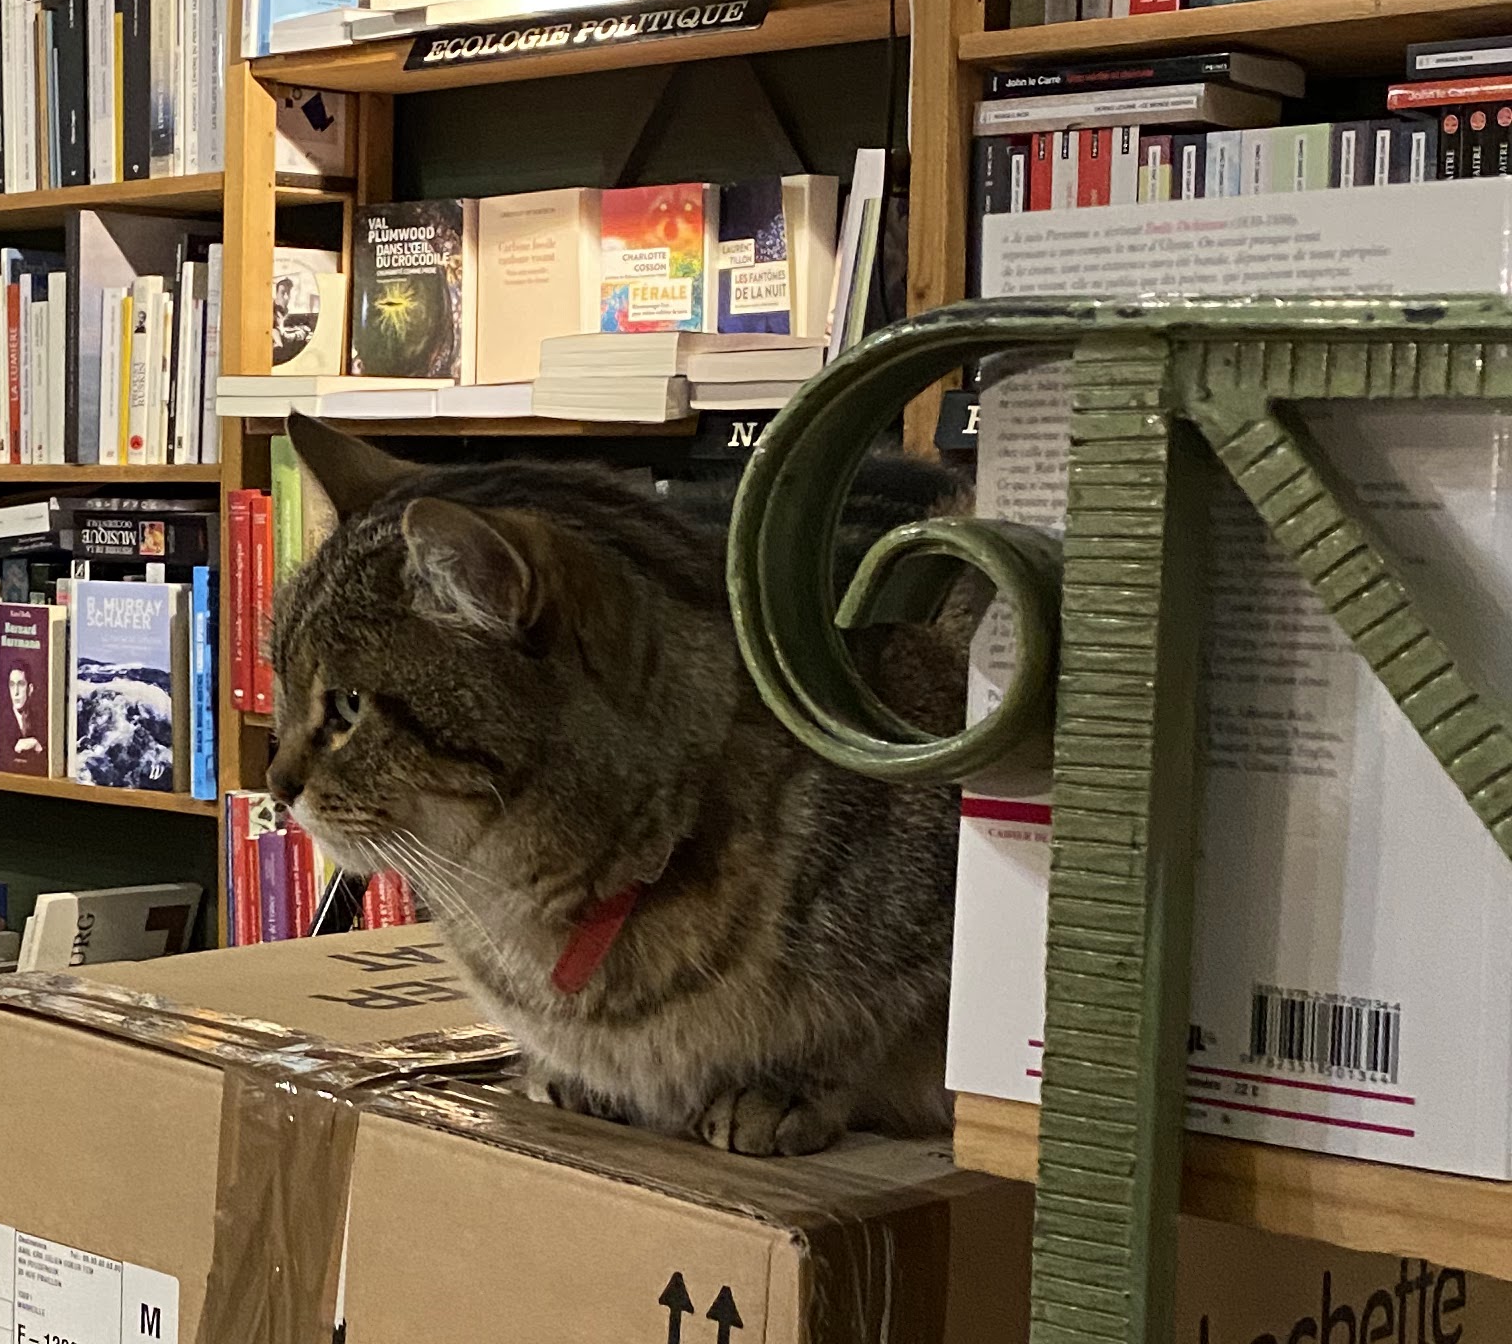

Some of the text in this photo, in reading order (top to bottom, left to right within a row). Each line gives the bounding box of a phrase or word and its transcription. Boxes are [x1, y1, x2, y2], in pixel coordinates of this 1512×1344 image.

[424, 0, 749, 64] ECOLOGIE POLITIQUE
[1005, 75, 1062, 89] John le Carré
[368, 217, 389, 230] VAL
[368, 226, 435, 243] PLUMWOOD
[376, 242, 430, 256] DANS L'ŒIL
[722, 242, 752, 255] LAURENT
[376, 252, 450, 268] DU CROCODILE
[622, 252, 667, 262] CHARLOTTE
[730, 254, 753, 264] TILLON
[634, 263, 667, 272] COSSON
[735, 268, 786, 284] LES FANTÔMES
[632, 281, 688, 302] FÉRALE
[735, 284, 786, 300] DE LA NUIT
[11, 386, 18, 401] LA
[82, 528, 136, 545] MUSIQUE
[103, 598, 162, 617] MURRAY
[5, 622, 36, 635] Bernard
[87, 612, 152, 629] SCHAFER
[140, 1303, 161, 1339] M
